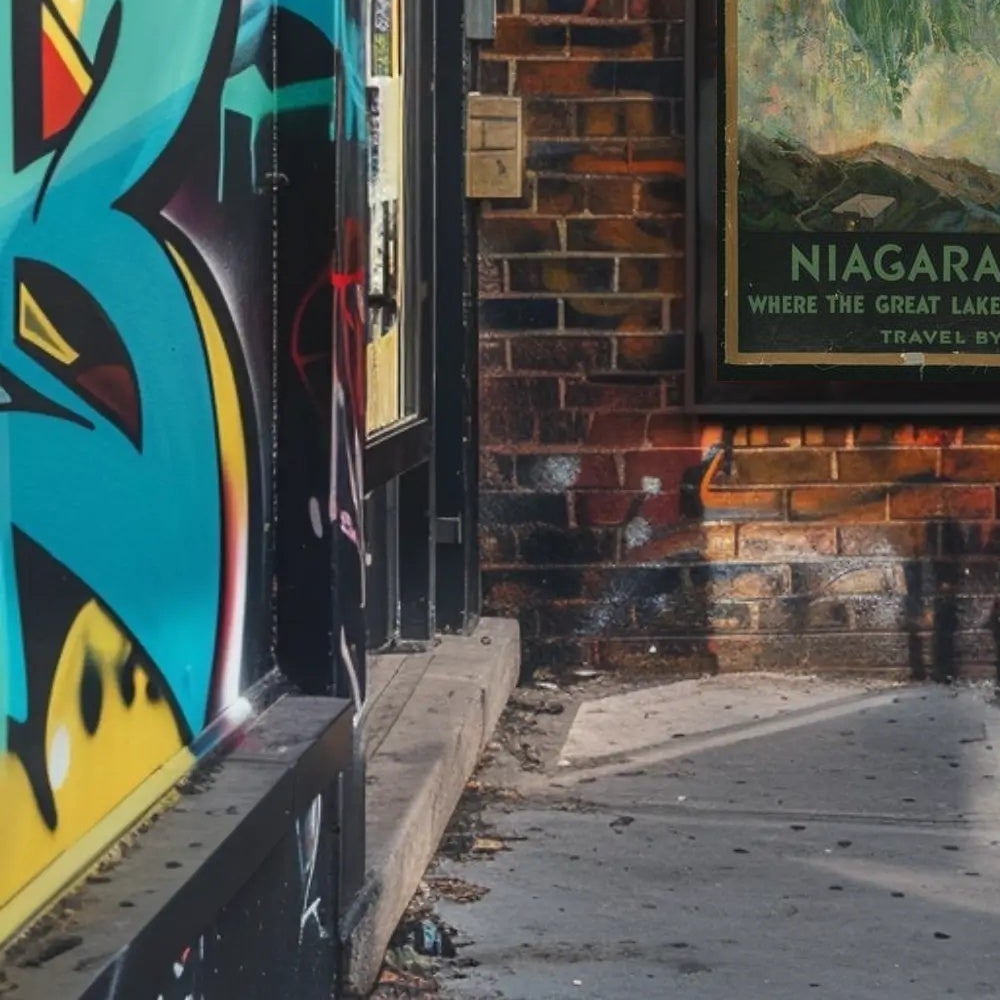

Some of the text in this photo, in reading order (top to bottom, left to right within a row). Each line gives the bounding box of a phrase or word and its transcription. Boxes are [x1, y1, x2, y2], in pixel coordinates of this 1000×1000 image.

[748, 295, 818, 315] WHERE
[825, 295, 865, 315] THE
[875, 295, 941, 316] GREAT
[881, 329, 966, 345] TRAVEL
